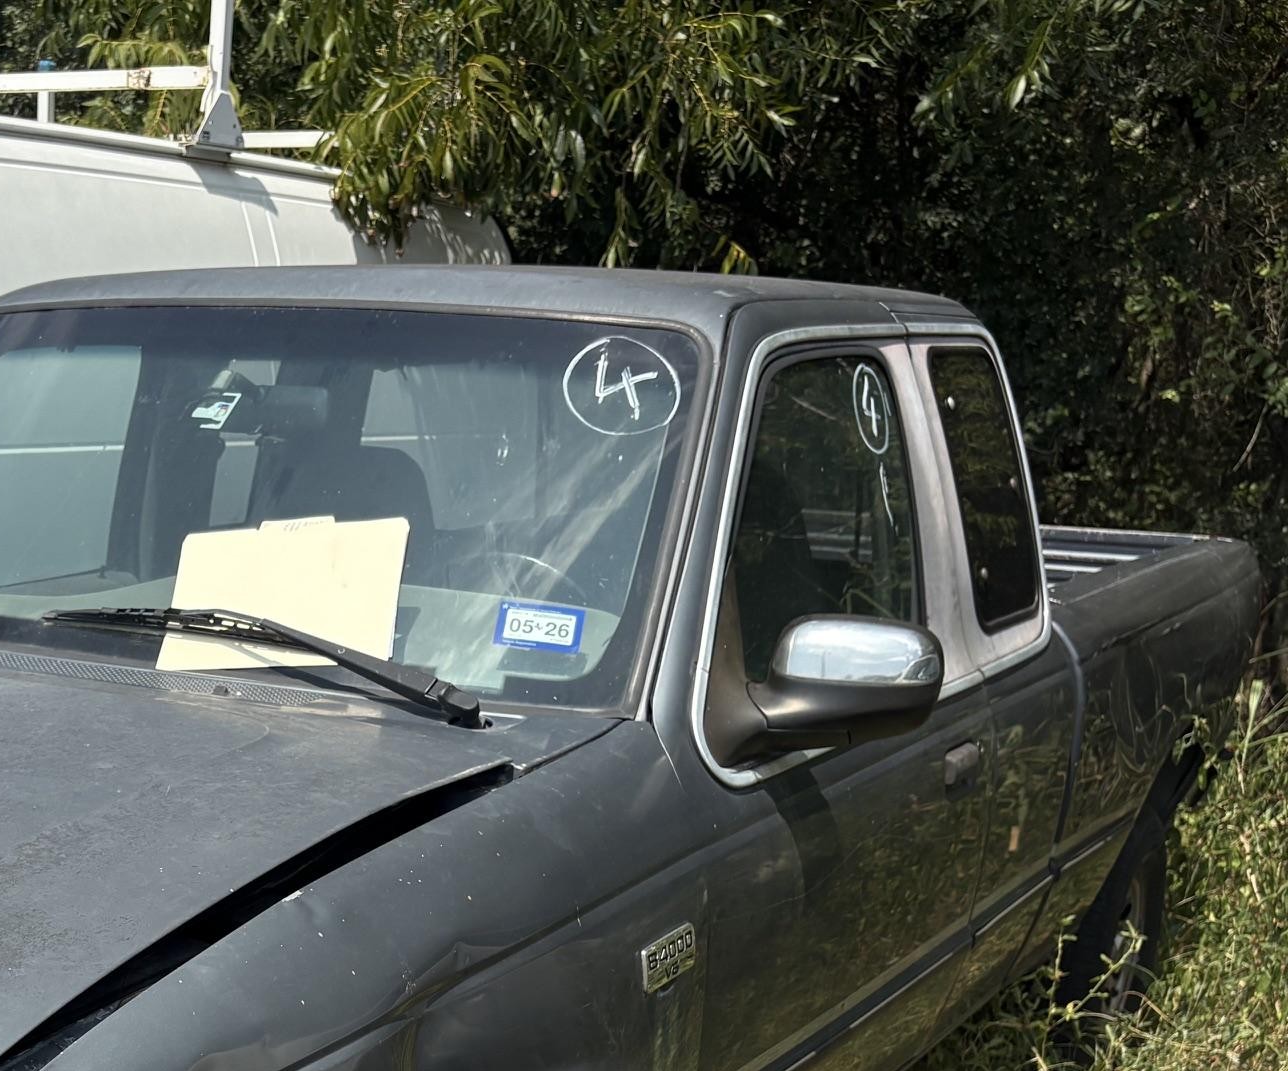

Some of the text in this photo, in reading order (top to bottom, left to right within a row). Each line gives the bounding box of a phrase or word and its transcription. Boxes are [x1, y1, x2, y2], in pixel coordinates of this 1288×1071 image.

[594, 346, 659, 421] 4
[861, 373, 881, 438] 4
[647, 930, 693, 971] B4000
[665, 960, 680, 979] V6
